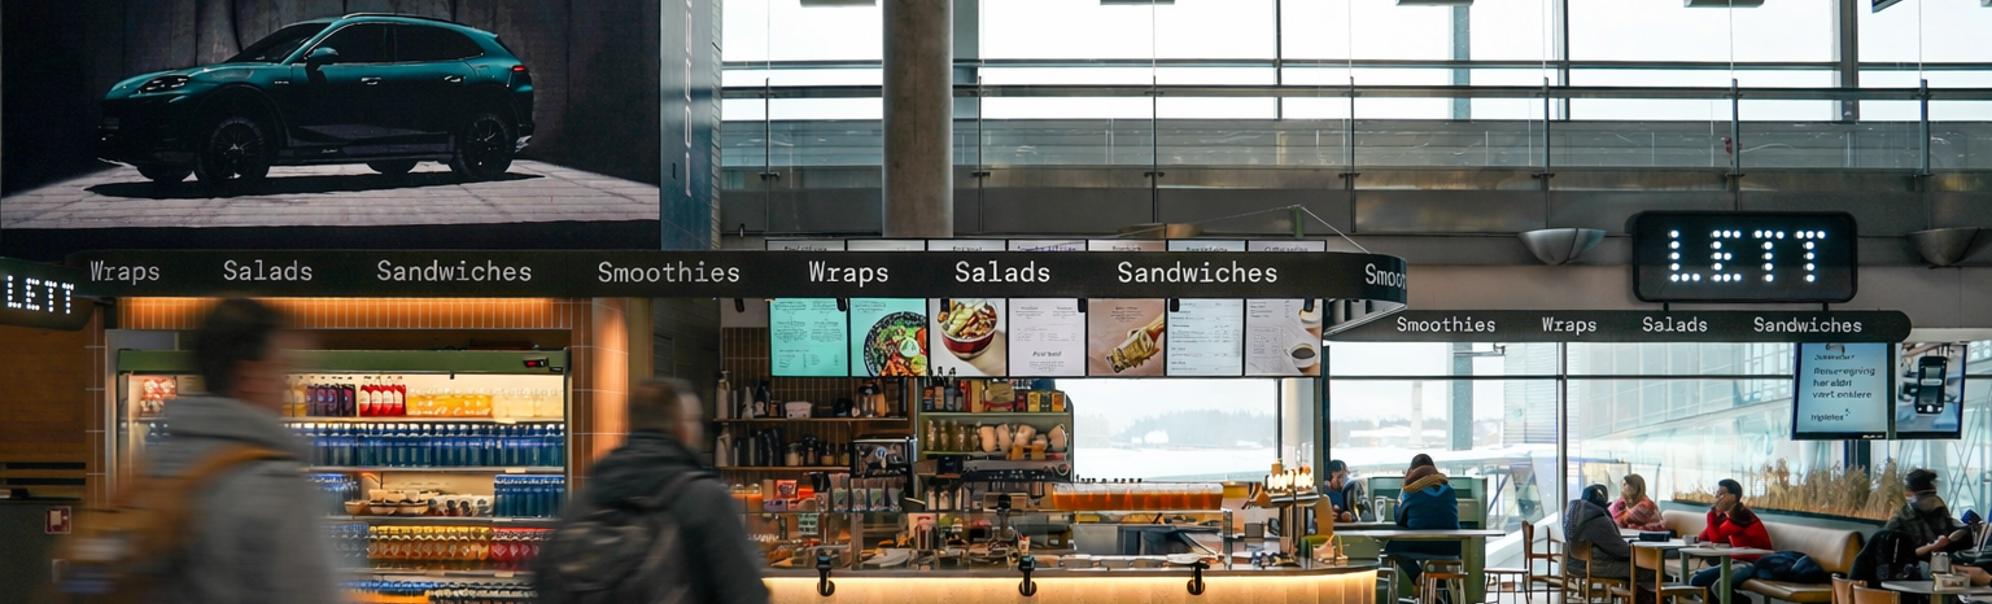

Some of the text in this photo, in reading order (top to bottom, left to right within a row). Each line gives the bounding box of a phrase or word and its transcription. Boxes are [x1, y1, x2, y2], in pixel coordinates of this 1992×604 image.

[1669, 230, 1826, 282] LETT
[90, 260, 160, 285] Wraps
[223, 259, 313, 281] Salads
[377, 259, 532, 282] Sandwiches
[598, 260, 740, 283] Smoothies
[808, 260, 889, 287] Wraps
[955, 260, 1051, 283] Salads
[1117, 260, 1278, 284] Sandwiches
[7, 275, 74, 314] LETT
[1396, 316, 1862, 337] Smoothies Wraps Salads Sandwiches
